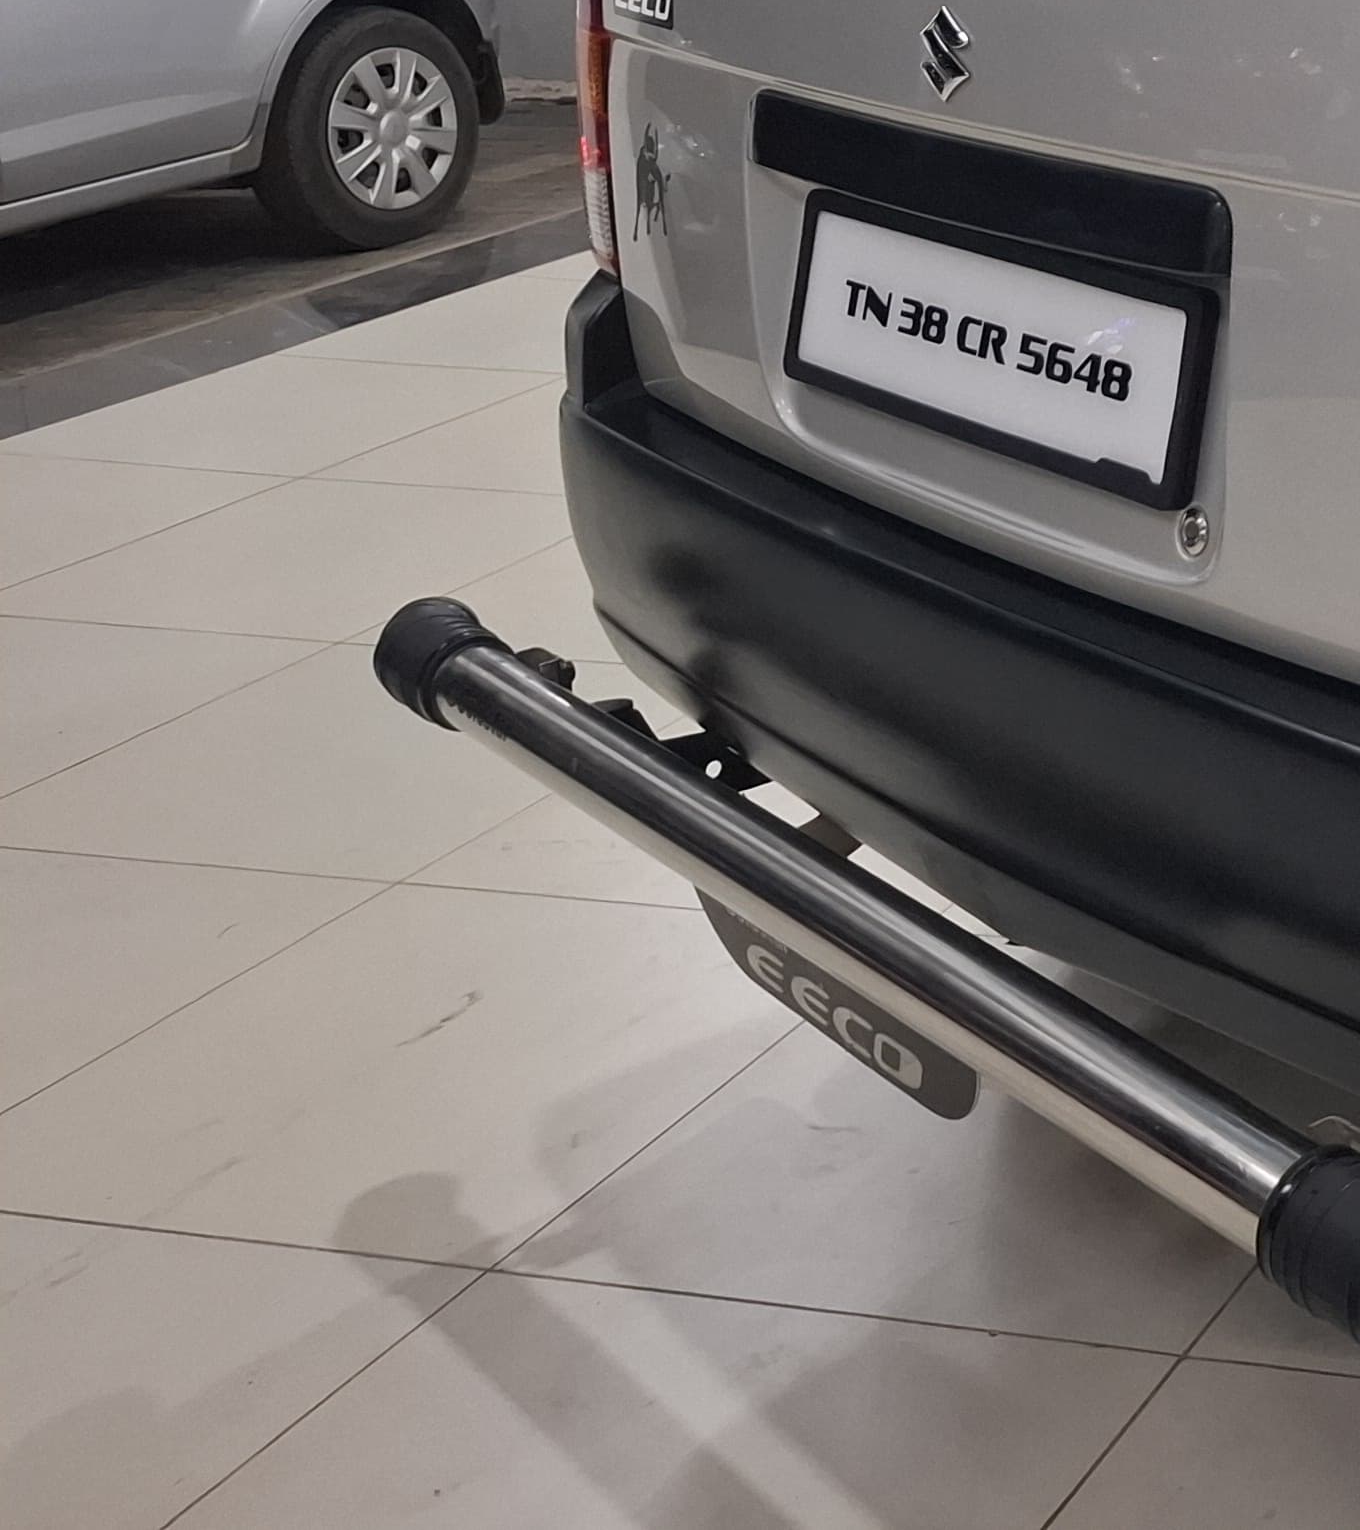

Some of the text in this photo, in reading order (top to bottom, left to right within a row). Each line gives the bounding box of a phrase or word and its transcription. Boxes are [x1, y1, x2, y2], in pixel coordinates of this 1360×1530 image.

[845, 278, 1133, 402] TN 38 CR 5648
[746, 944, 924, 1090] EECO
